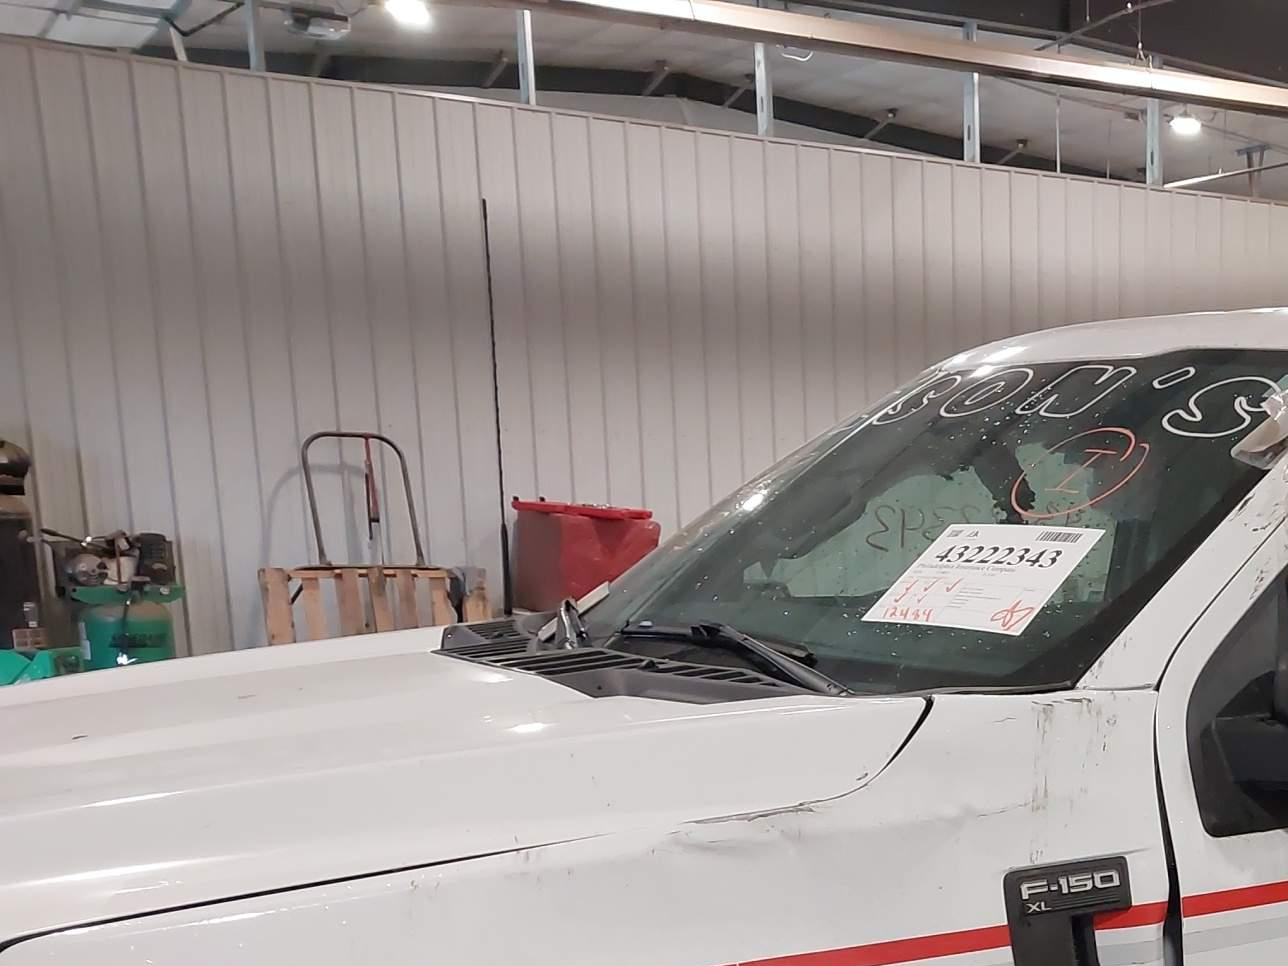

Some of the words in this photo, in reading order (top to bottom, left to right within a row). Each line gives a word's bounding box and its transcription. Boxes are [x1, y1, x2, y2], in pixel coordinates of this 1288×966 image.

[935, 544, 1063, 569] 43222343
[1020, 869, 1120, 900] F-150
[1026, 902, 1052, 914] XL
